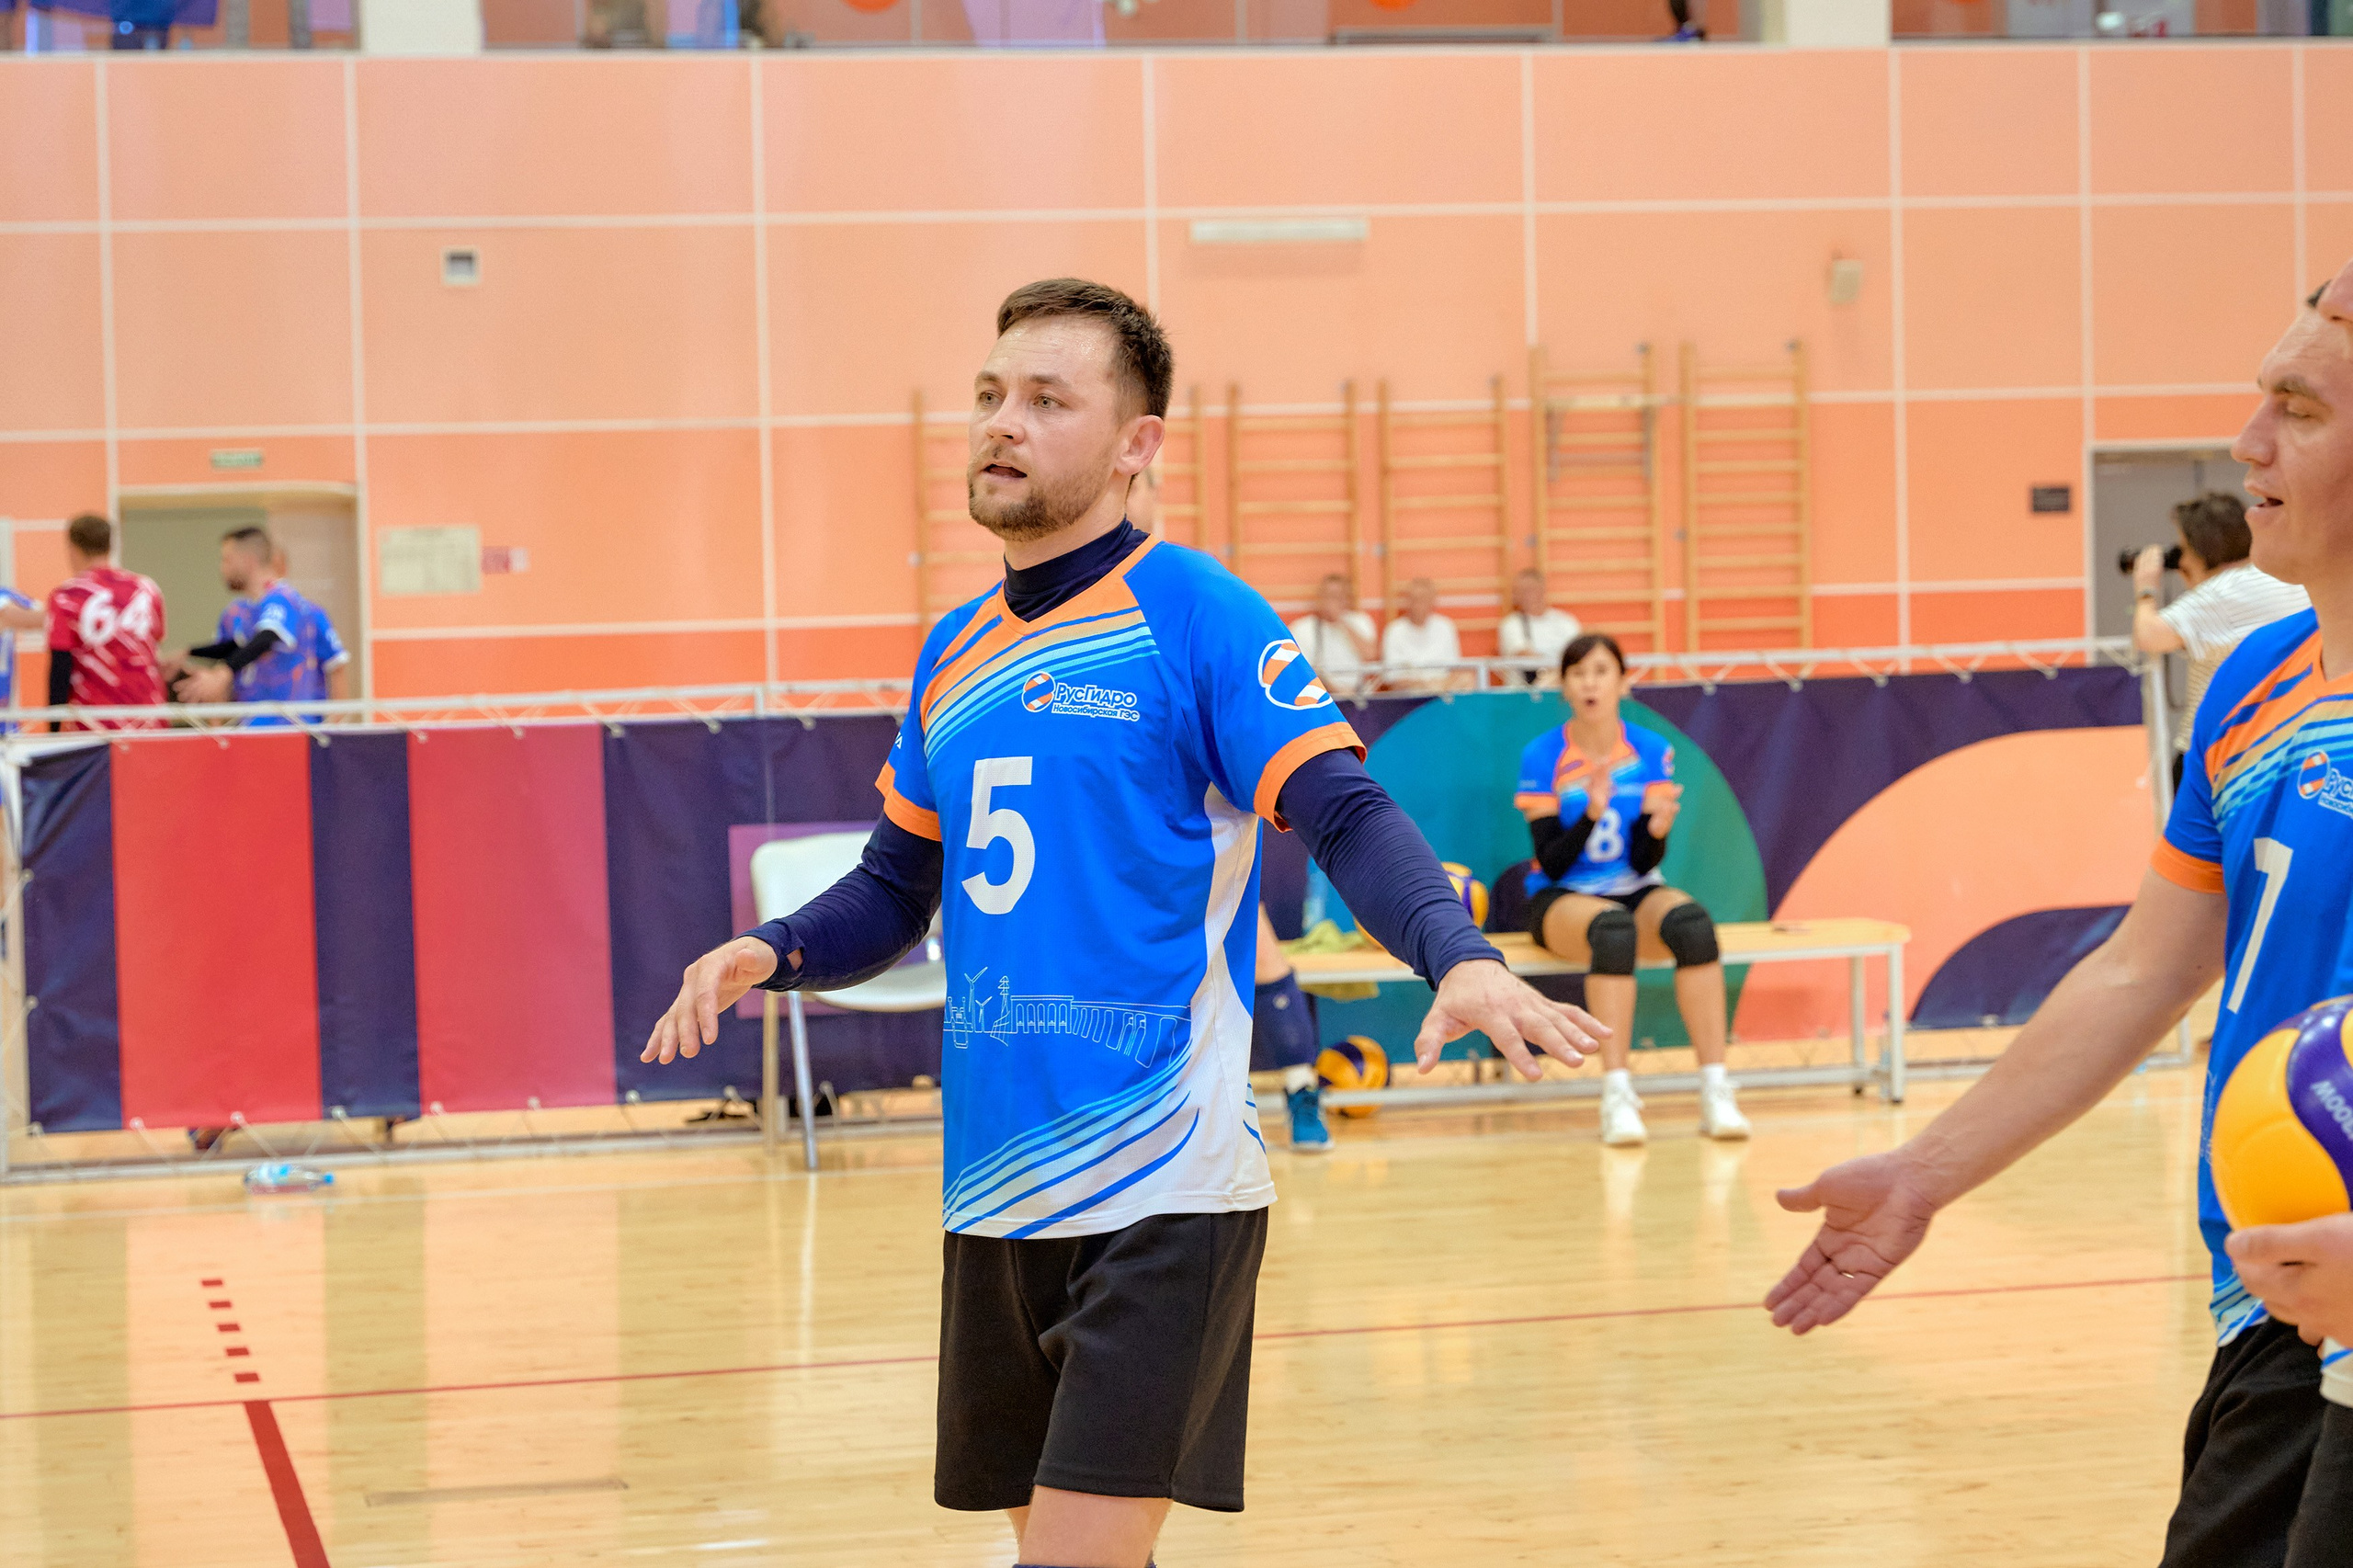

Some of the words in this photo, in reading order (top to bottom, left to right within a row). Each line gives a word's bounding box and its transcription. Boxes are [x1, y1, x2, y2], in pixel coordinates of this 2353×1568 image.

[79, 589, 153, 644] 64
[1052, 704, 1118, 717] Новосибирская
[1119, 710, 1140, 721] ГЭС
[1055, 683, 1136, 707] РусГидро
[2324, 767, 2353, 801] Рус
[961, 756, 1036, 915] 5
[1586, 807, 1625, 864] 8
